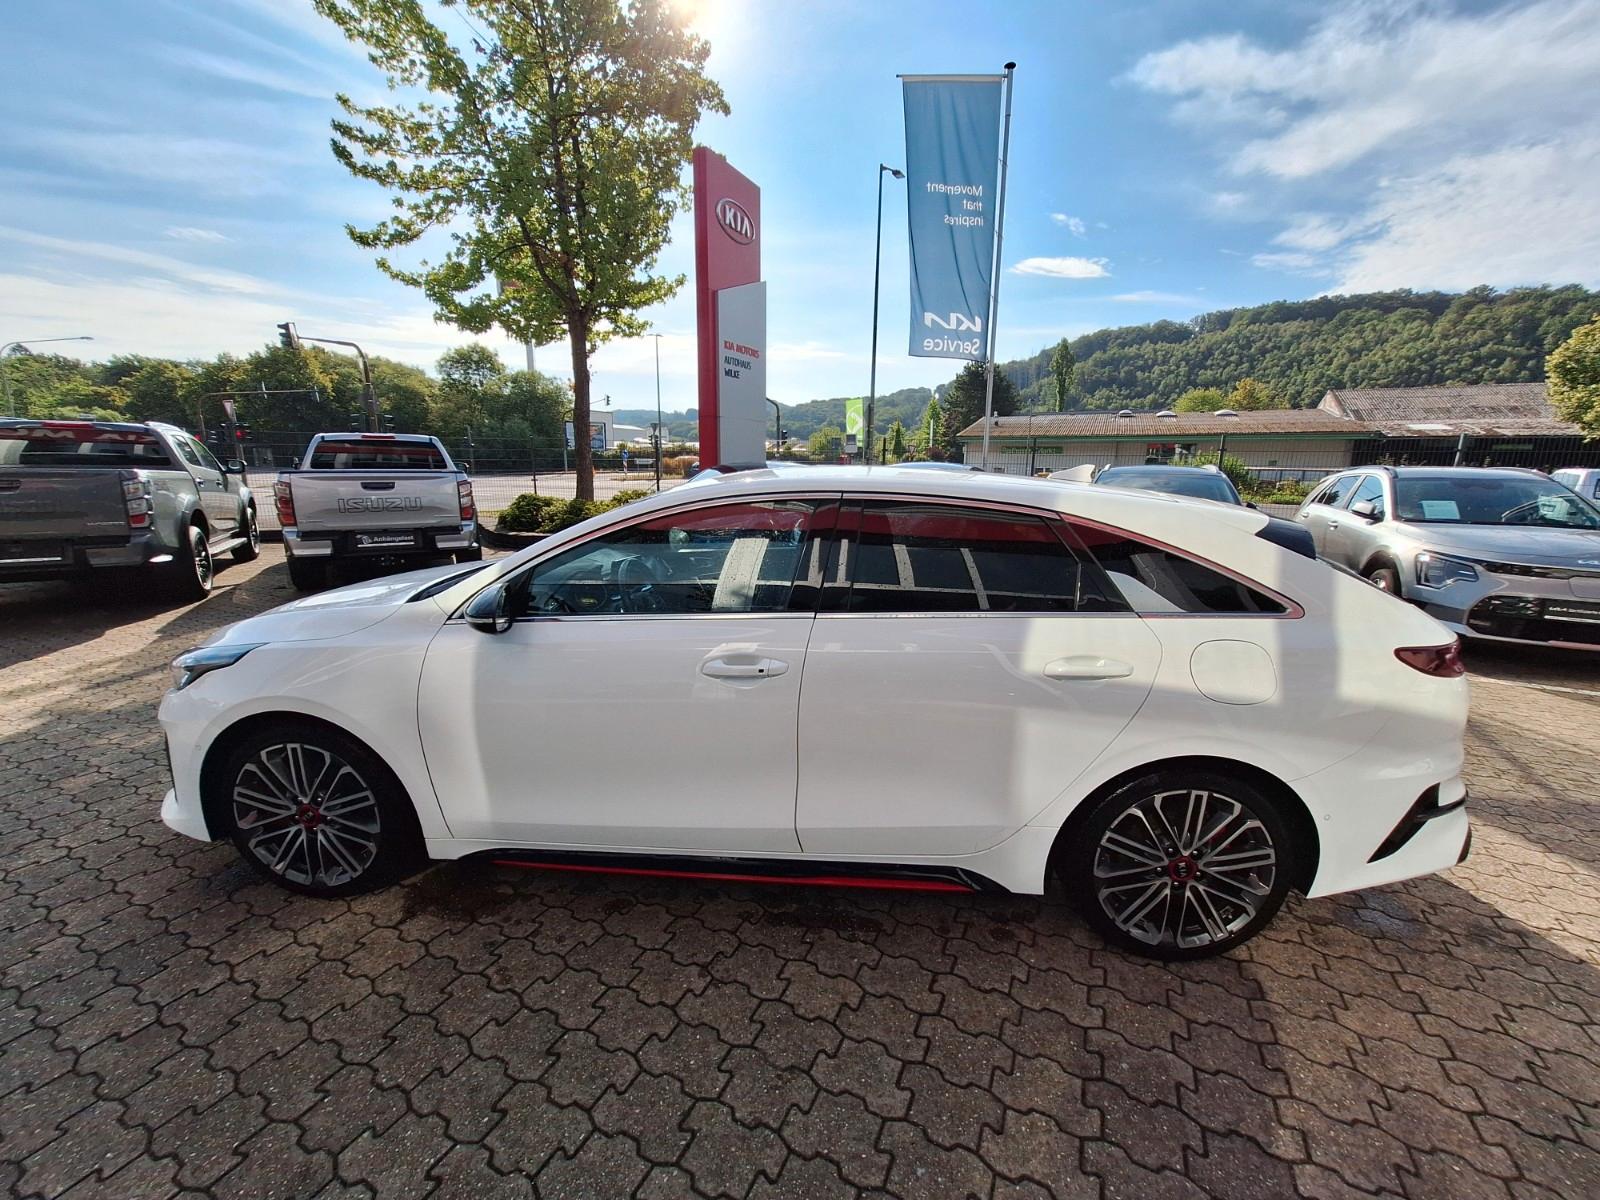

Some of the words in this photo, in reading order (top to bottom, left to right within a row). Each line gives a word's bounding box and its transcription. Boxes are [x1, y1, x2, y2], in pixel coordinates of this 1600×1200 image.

[724, 204, 751, 238] KIA
[724, 340, 735, 352] KIA
[735, 343, 760, 359] MOTORS
[724, 355, 752, 370] AUTOHAUS
[724, 367, 741, 380] WILKE
[337, 496, 423, 514] ISUZU
